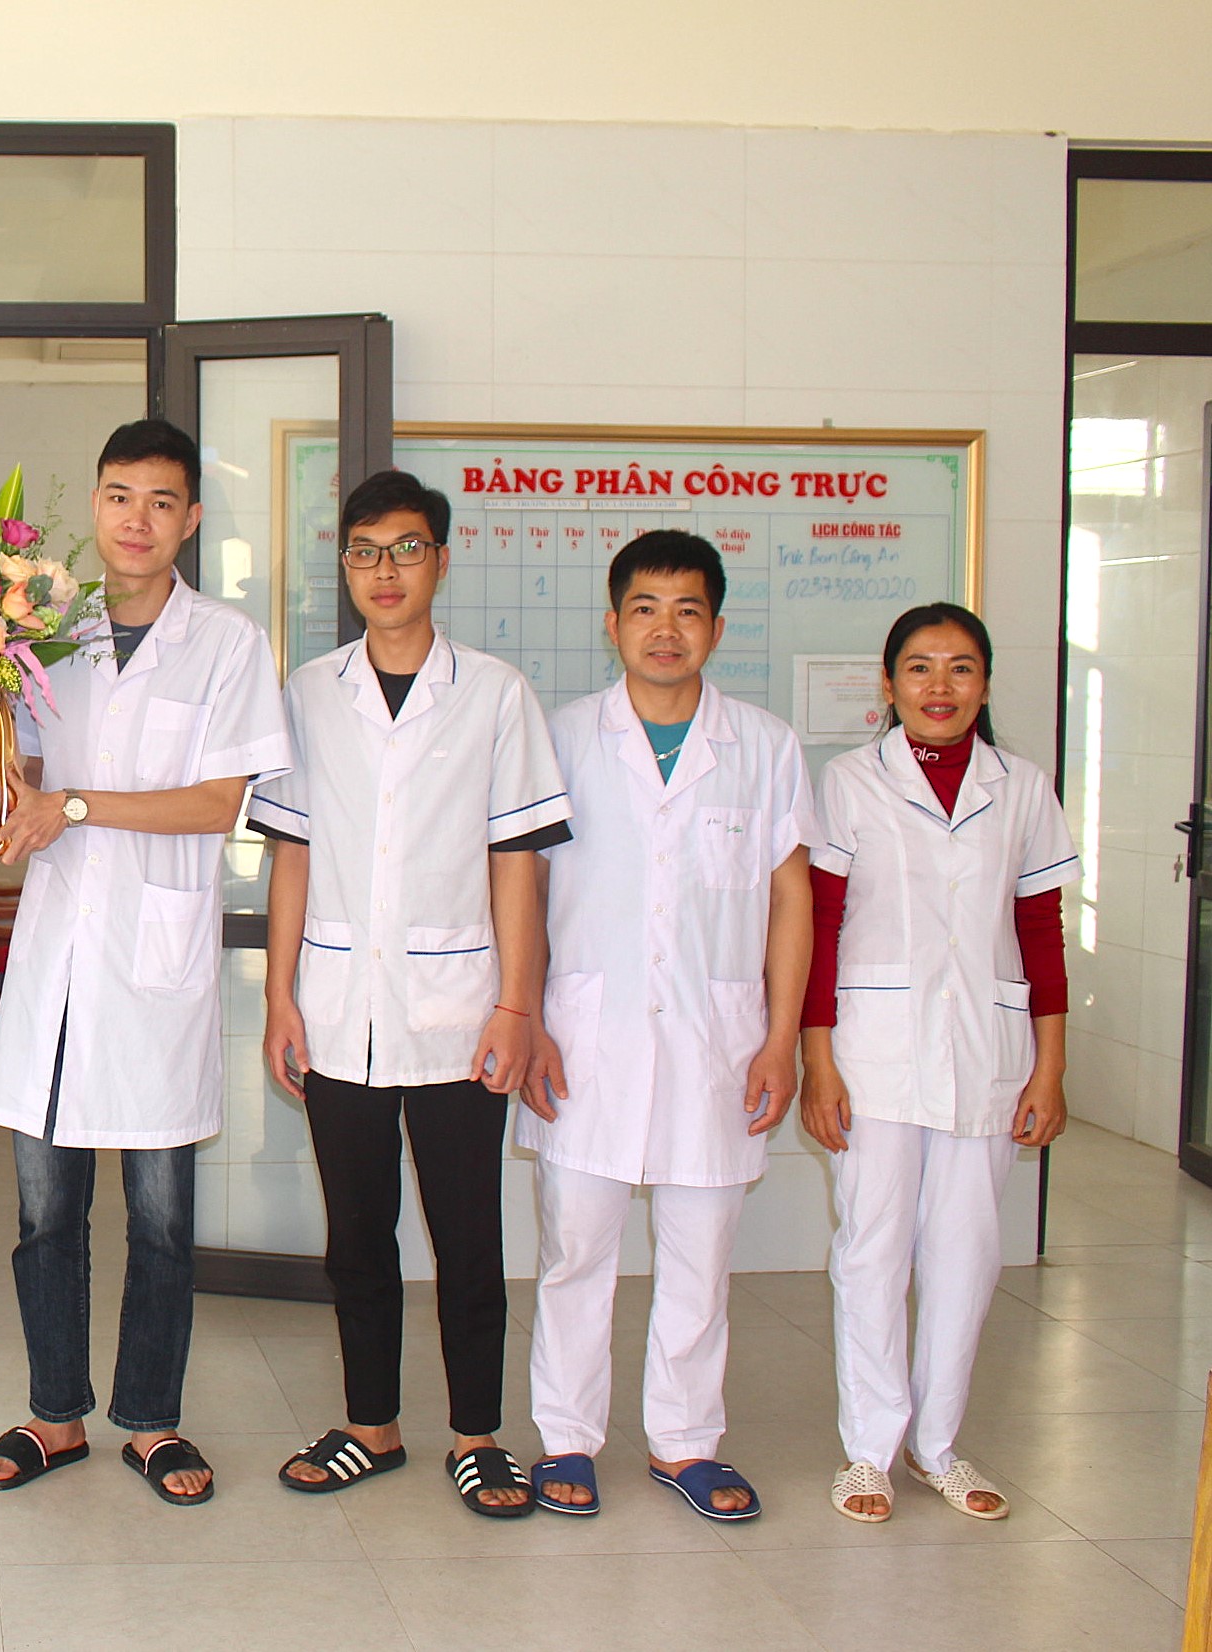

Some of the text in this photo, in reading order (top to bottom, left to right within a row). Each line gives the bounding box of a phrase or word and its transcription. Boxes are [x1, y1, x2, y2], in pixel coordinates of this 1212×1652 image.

[463, 457, 888, 504] BẢNG PHÂN CÔNG TRỰC
[716, 528, 751, 541] Số điện
[812, 520, 901, 539] LỊCH CÔNG TÁC
[465, 539, 472, 548] 2
[501, 540, 507, 549] 3
[536, 540, 543, 549] 4
[572, 540, 578, 549] 5
[606, 541, 613, 550] 6
[721, 542, 745, 553] thoại
[877, 545, 900, 565] An
[535, 575, 549, 595] 1
[496, 618, 510, 638] 1
[604, 659, 617, 680] 1
